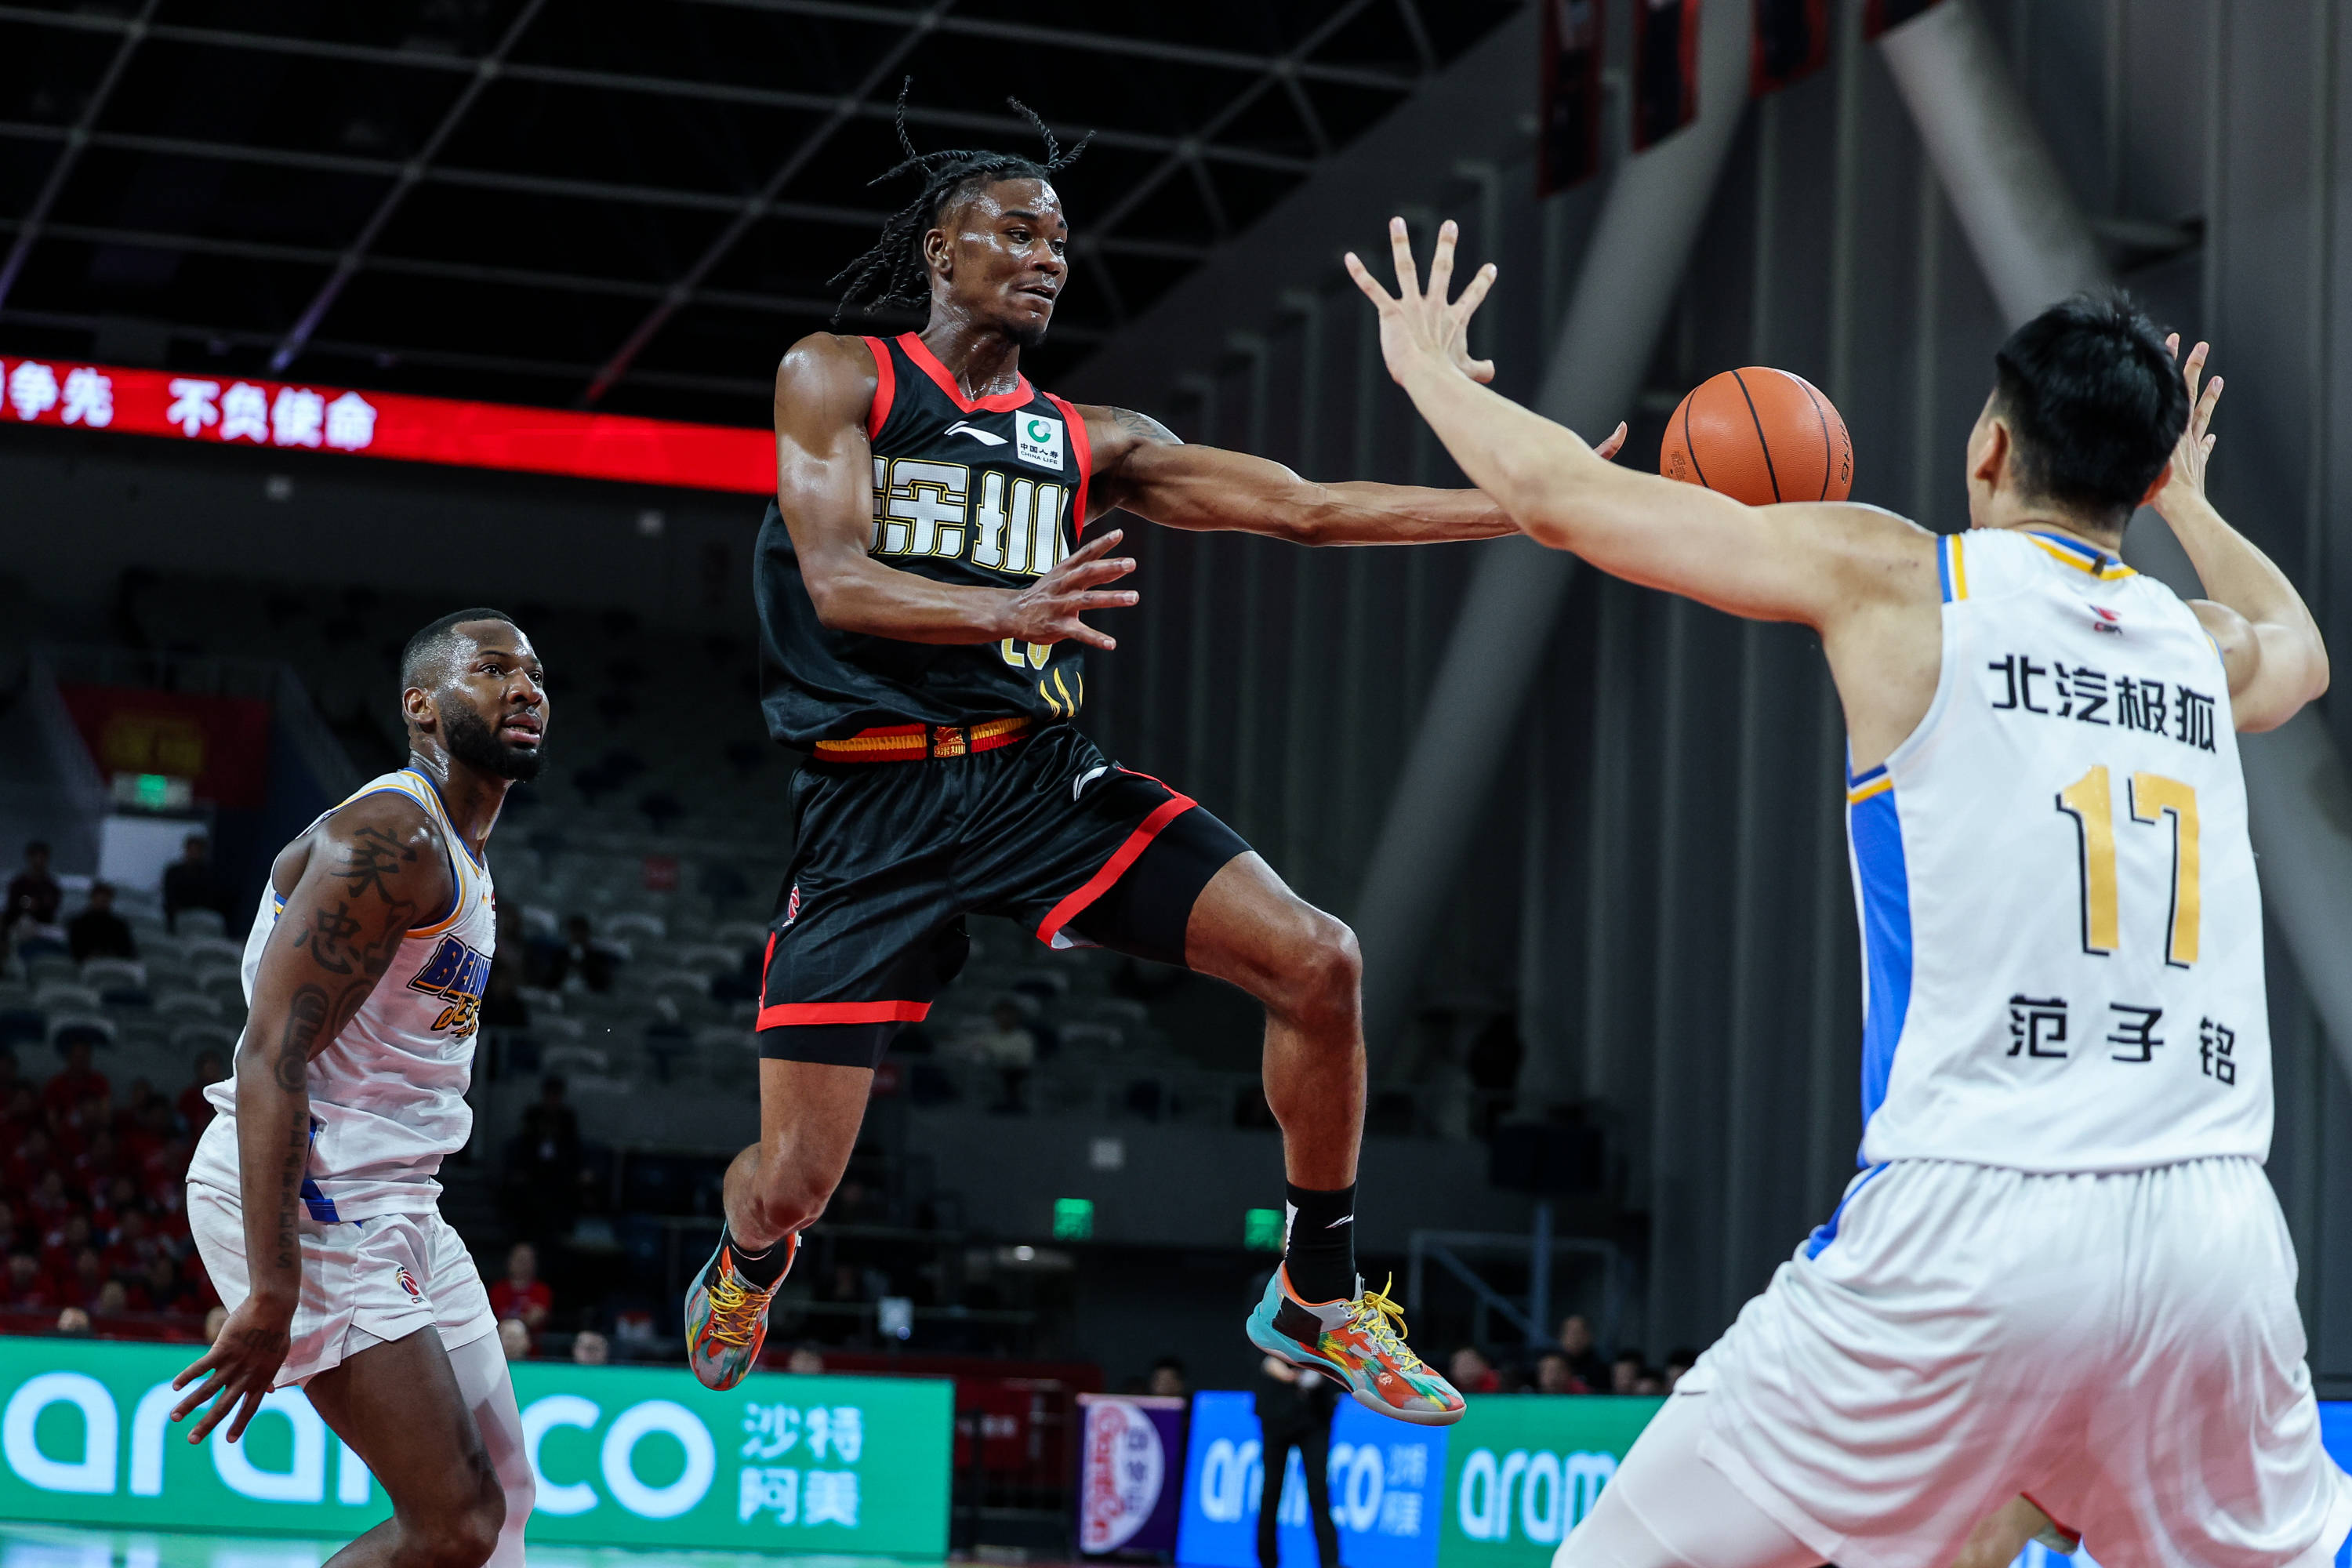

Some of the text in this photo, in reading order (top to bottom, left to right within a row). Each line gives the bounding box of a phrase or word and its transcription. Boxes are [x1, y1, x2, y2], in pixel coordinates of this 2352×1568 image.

[0, 359, 377, 451] 争先 不负使命
[1021, 443, 1058, 459] 中国人寿
[1021, 451, 1041, 460] CHINA
[1988, 654, 2216, 754] 北汽极狐
[2055, 764, 2201, 969] 17
[2006, 994, 2236, 1087] 范子铭
[742, 1402, 863, 1463] 沙特
[739, 1468, 861, 1527] 阿美
[1200, 1436, 1385, 1533] arco
